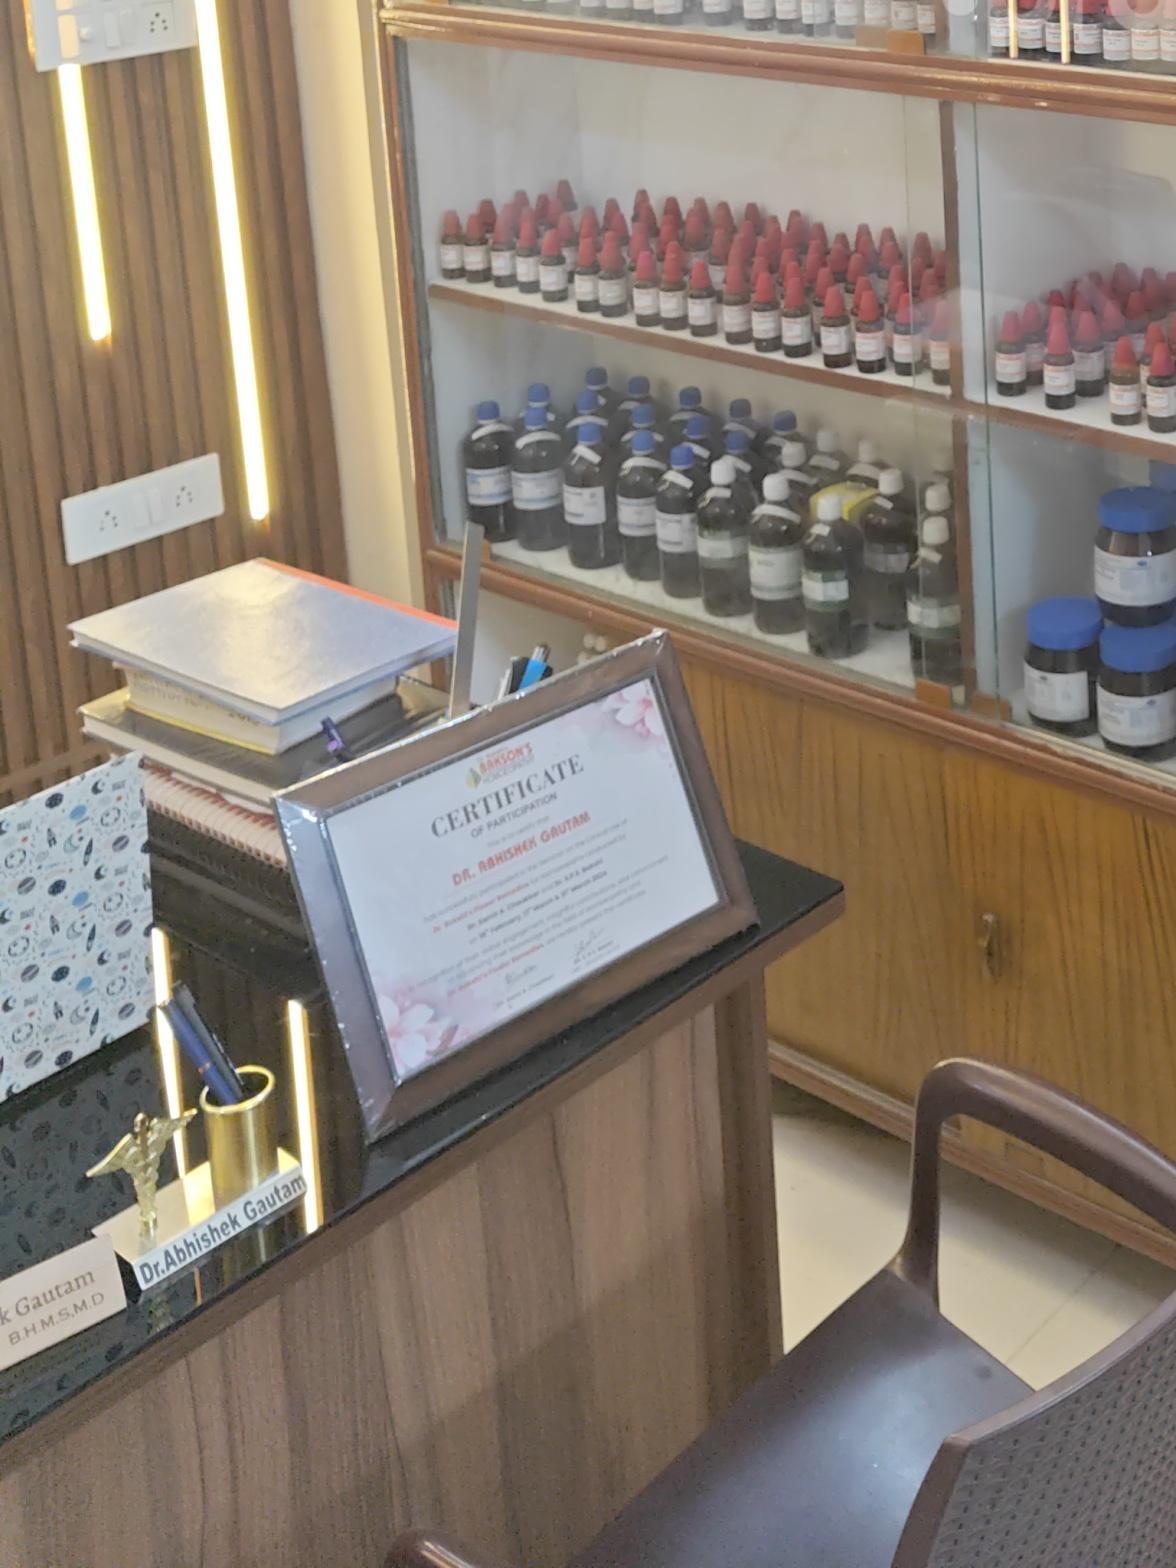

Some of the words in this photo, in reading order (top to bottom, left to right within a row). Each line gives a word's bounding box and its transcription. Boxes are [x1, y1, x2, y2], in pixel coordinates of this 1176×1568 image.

[479, 742, 534, 774] BAKSON'S
[430, 753, 585, 837] CERTIFICATE
[470, 825, 485, 839] OF
[487, 791, 558, 831] PARTICIPATION
[452, 867, 476, 887] DR.
[477, 837, 538, 874] ABHISHEK
[539, 810, 592, 844] GAUTAM
[138, 1212, 242, 1285] Dr.Abhishek
[243, 1173, 308, 1220] Gautam
[15, 1270, 96, 1317] Gautam
